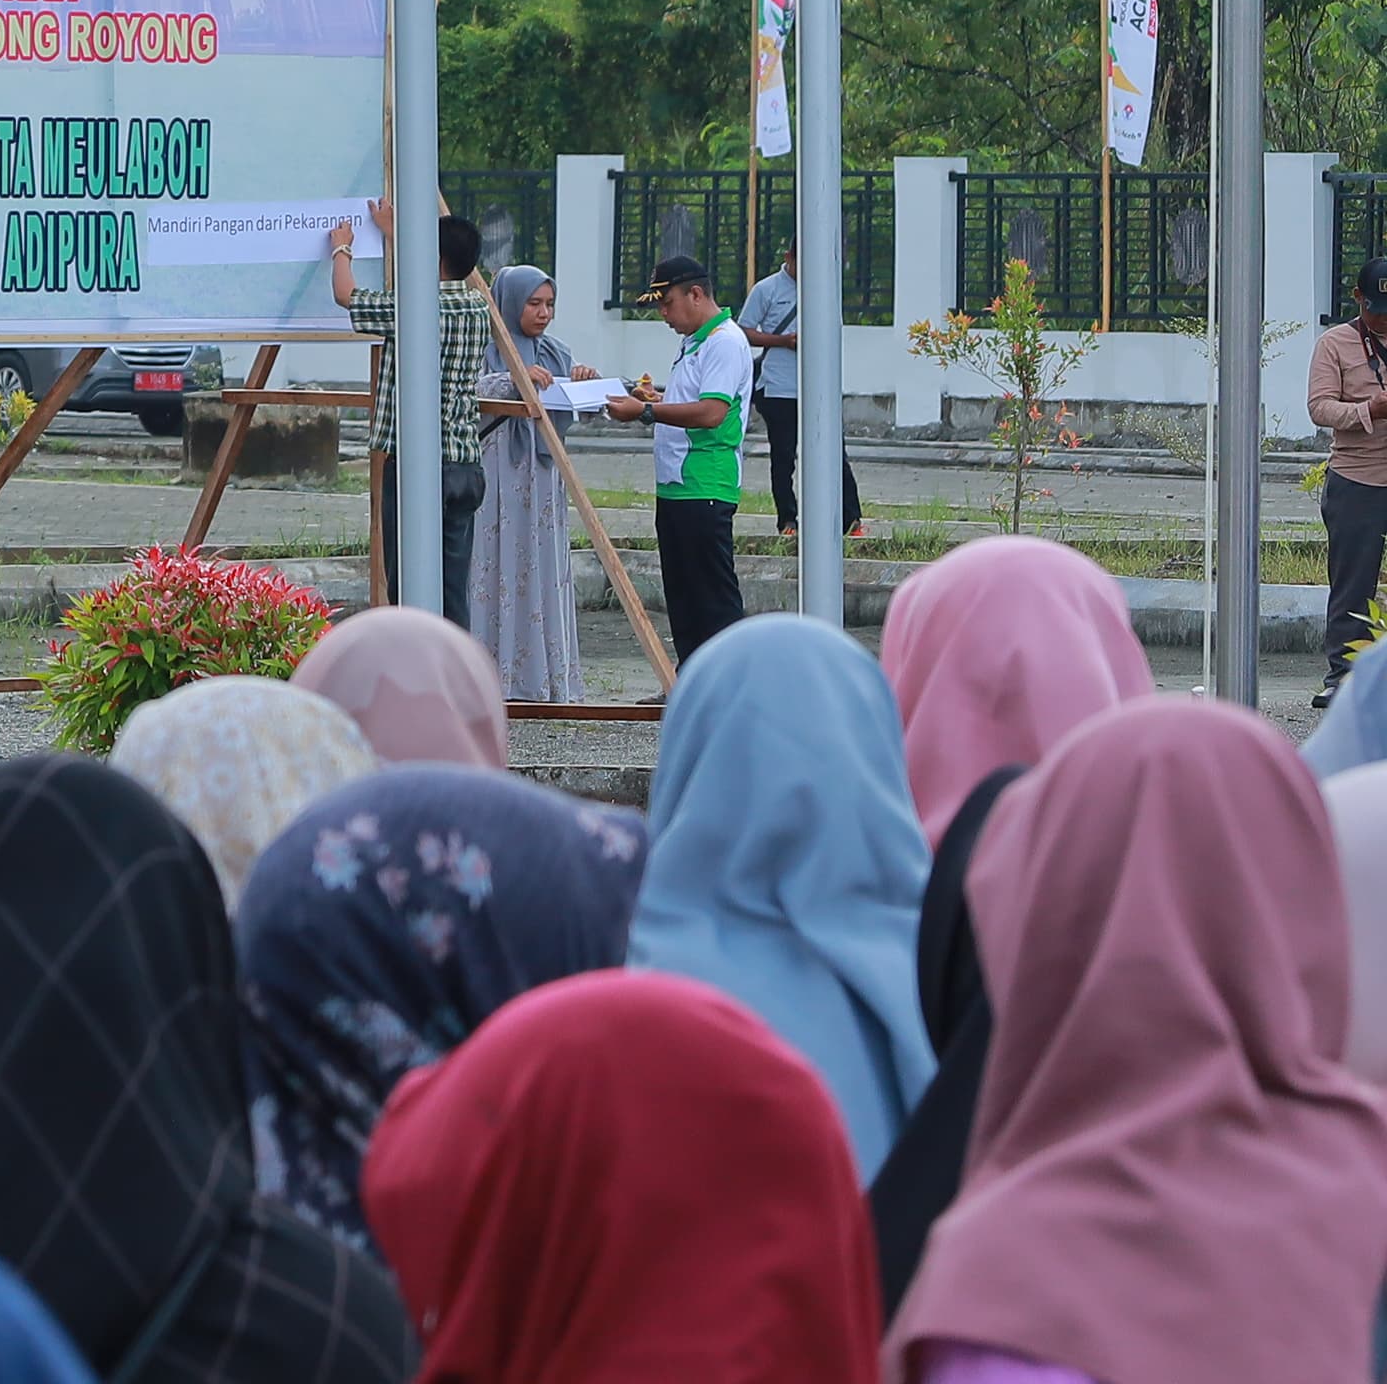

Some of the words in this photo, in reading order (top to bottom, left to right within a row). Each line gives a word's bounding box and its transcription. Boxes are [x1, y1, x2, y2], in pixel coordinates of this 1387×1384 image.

[67, 12, 218, 64] ROYONG
[41, 116, 210, 199] MEULABOH
[2, 211, 140, 293] ADIPURA
[147, 216, 202, 233] Mandiri
[205, 216, 254, 236] Pangan
[256, 214, 283, 233] dari
